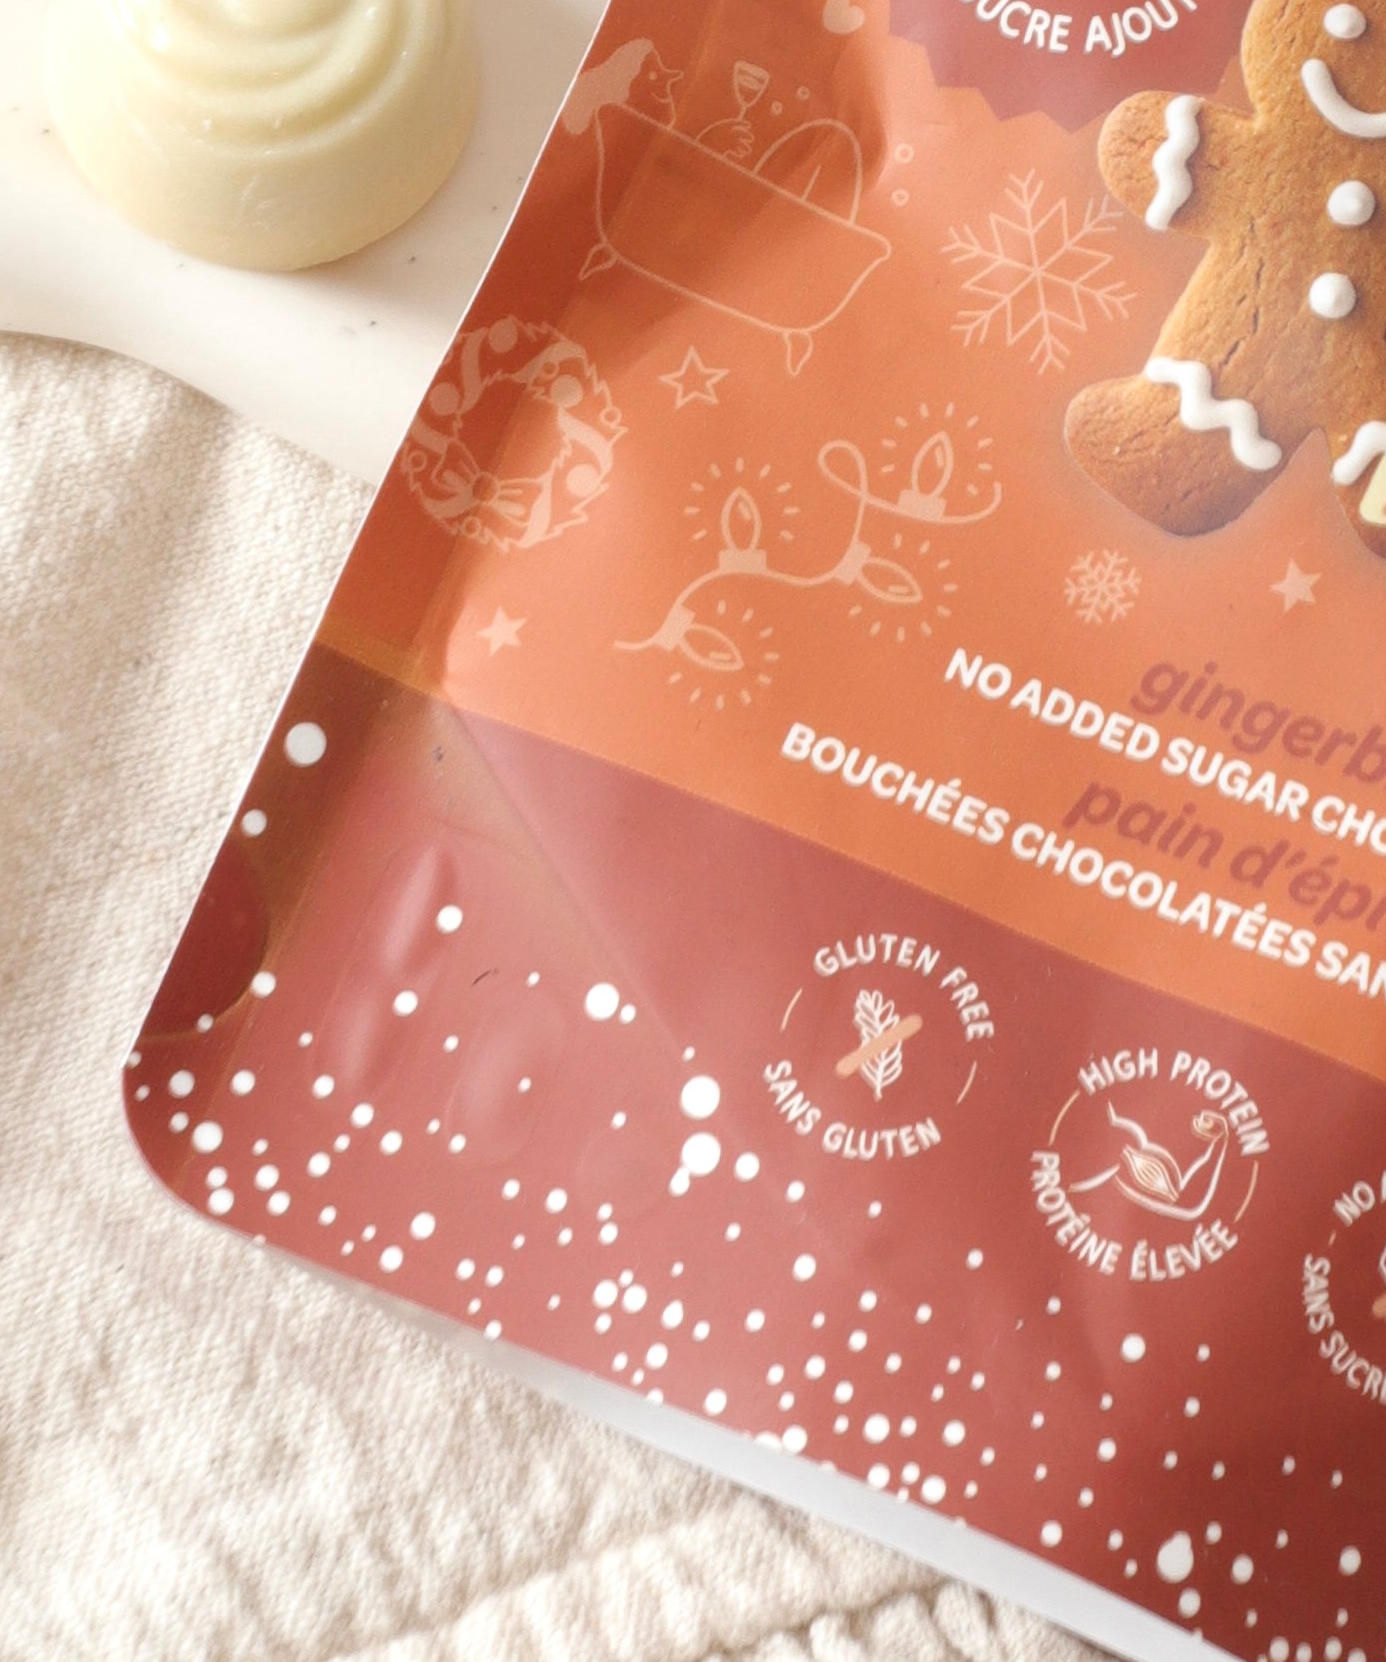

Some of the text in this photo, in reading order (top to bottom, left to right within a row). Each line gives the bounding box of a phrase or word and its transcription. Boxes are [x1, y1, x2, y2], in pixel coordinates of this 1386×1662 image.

[942, 645, 1009, 705] NO
[1007, 677, 1162, 763] ADDED
[1160, 736, 1311, 820] SUGAR
[780, 720, 1009, 847] BOUCHÉES
[1009, 820, 1318, 971] CHOCOLATÉES
[1062, 775, 1220, 872] pain
[812, 932, 996, 1044] GLUTEN FREE
[763, 1058, 943, 1161] SANS GLUTEN
[1076, 1047, 1272, 1158] HIGH PROTEIN
[1029, 1148, 1240, 1282] PROTÉINE ÉLEVÉE
[1332, 1179, 1377, 1227] NO
[1301, 1252, 1334, 1335] SANS
